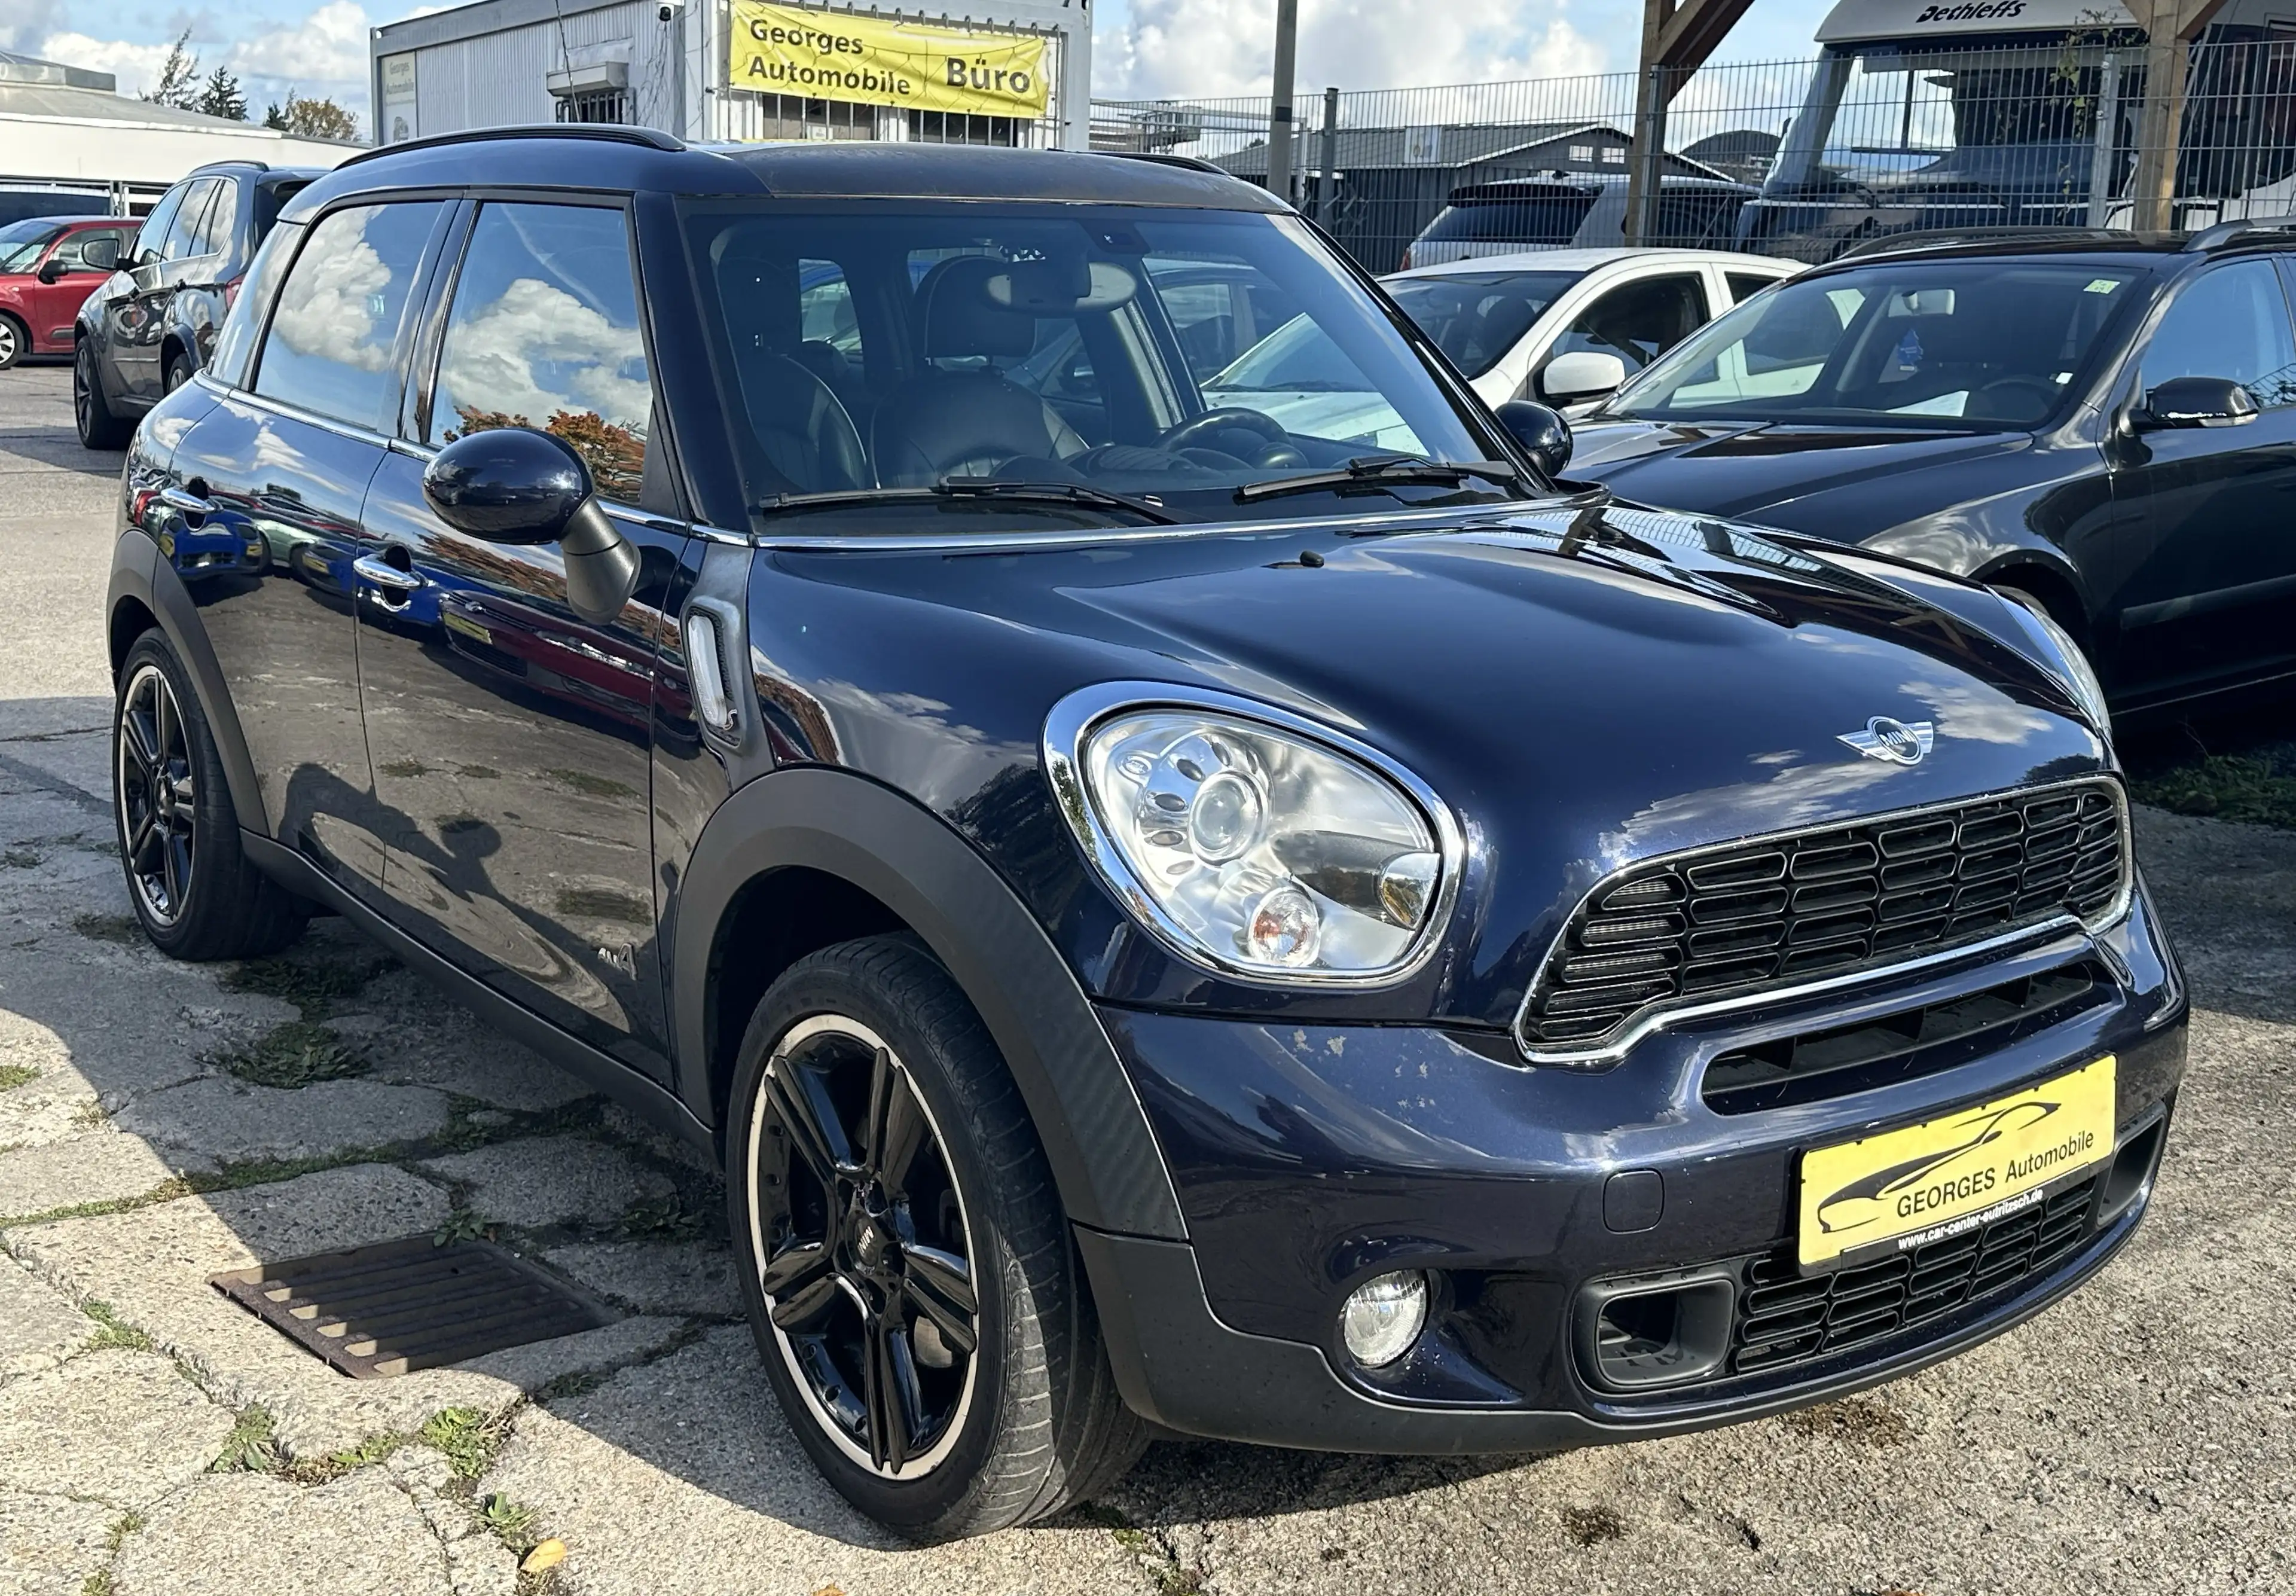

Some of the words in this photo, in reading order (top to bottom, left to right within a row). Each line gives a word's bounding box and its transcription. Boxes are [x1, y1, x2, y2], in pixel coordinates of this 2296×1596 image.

[1915, 0, 2027, 23] Dethleffs
[750, 19, 864, 56] Georges
[747, 56, 911, 96] Automobile
[946, 56, 1031, 94] Büro
[1879, 729, 1916, 746] MINI
[1897, 1167, 1996, 1218] GEORGES
[2005, 1130, 2094, 1183] Automobile
[1898, 1188, 2044, 1250] www.car-center-eutritzsch.de
